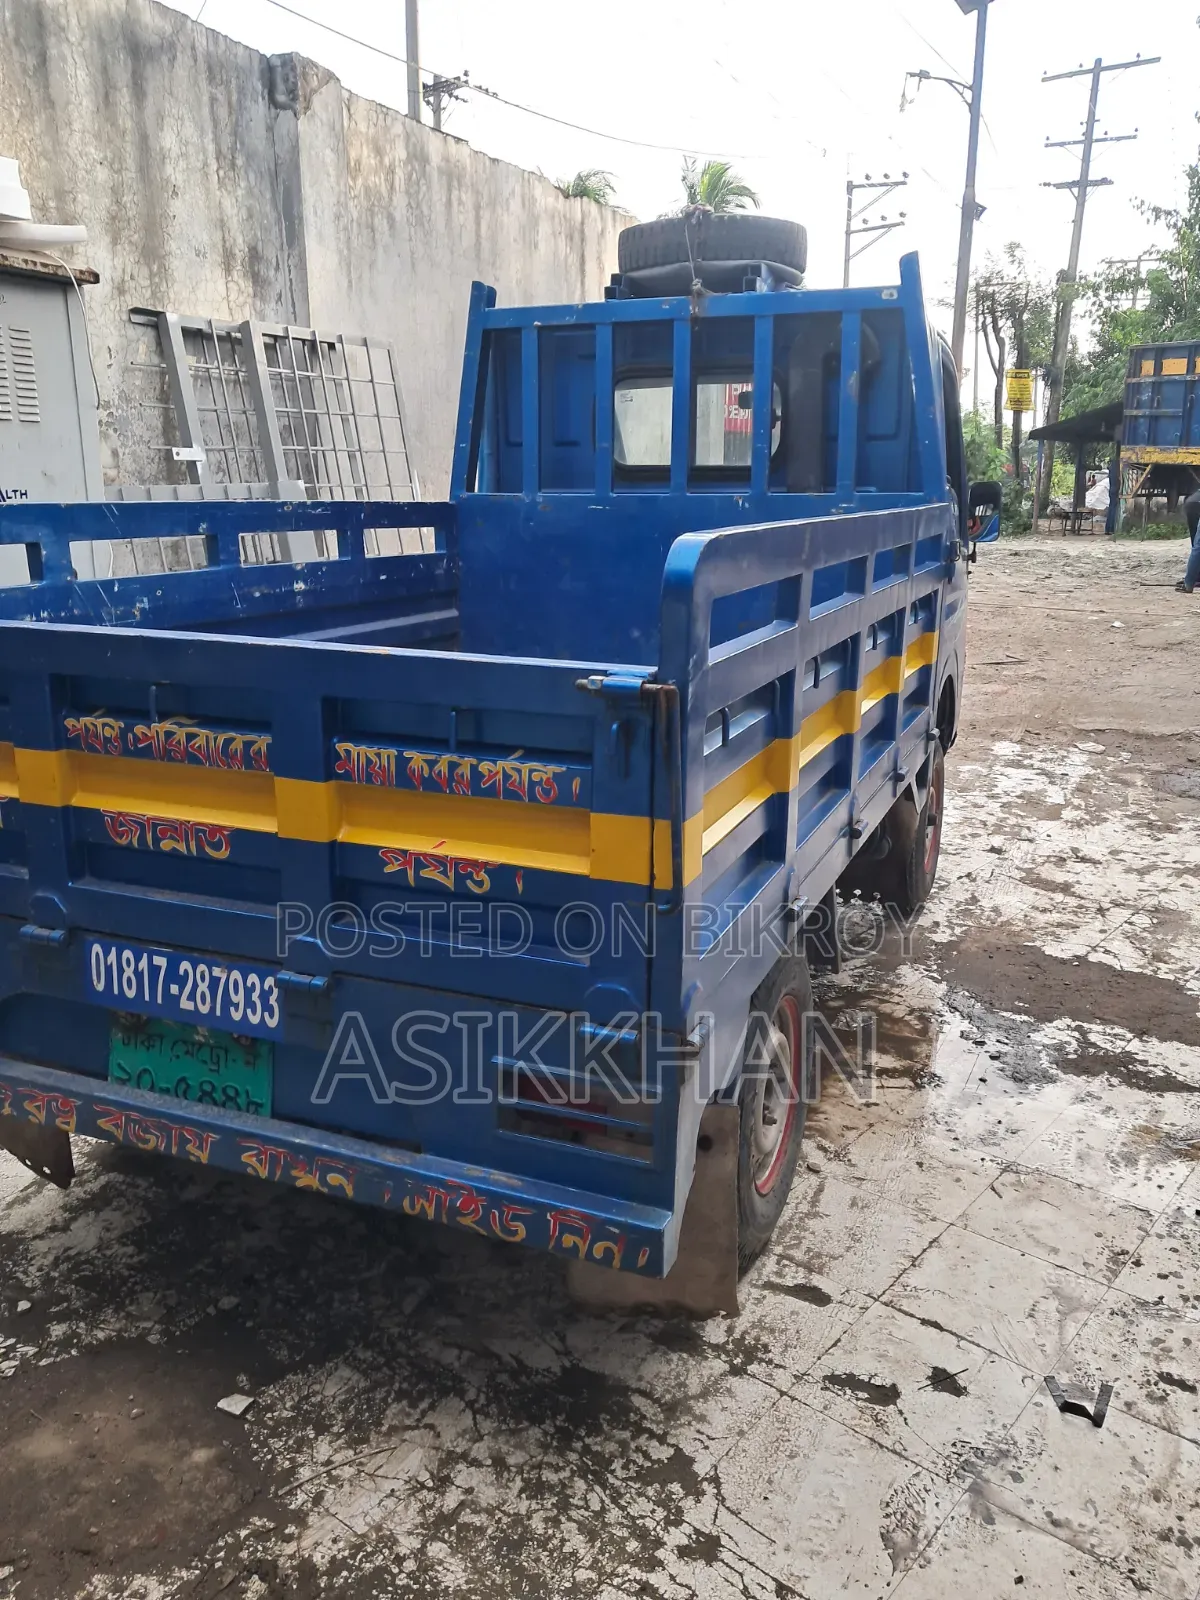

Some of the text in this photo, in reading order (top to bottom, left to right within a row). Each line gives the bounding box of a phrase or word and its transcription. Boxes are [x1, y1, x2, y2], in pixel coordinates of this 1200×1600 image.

[134, 716, 272, 771] পরিবারের
[335, 743, 398, 788] মায়া
[404, 751, 477, 796] কবর
[101, 808, 235, 860] জান্নাত
[90, 943, 280, 1028] 01817-287933
[93, 1104, 220, 1163] বজায়
